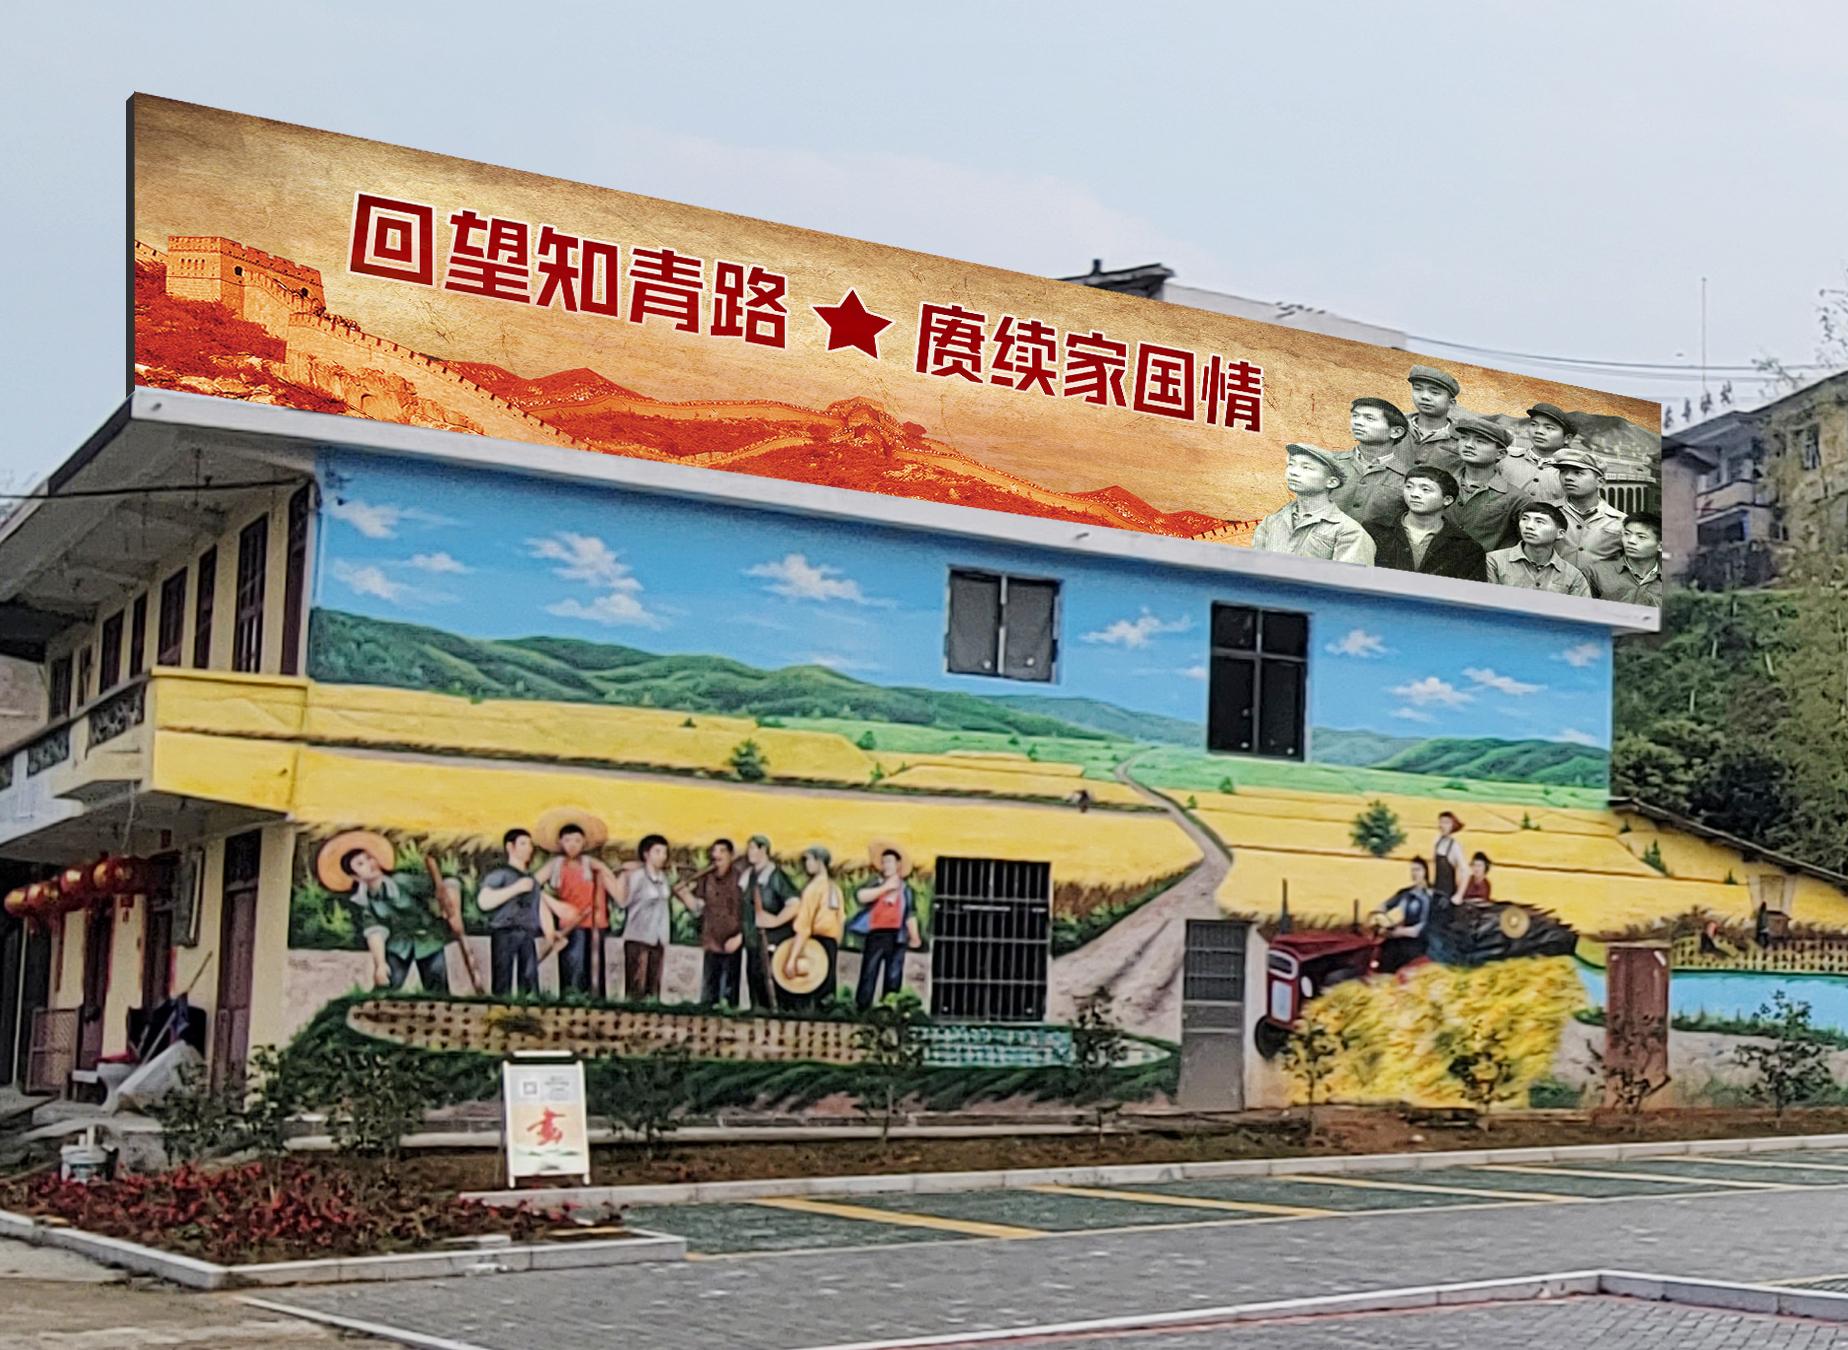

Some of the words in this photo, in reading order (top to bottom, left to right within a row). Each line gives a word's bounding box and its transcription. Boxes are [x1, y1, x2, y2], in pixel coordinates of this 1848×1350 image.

[350, 193, 789, 348] 回望知青路
[915, 303, 1265, 432] 赓续家国情
